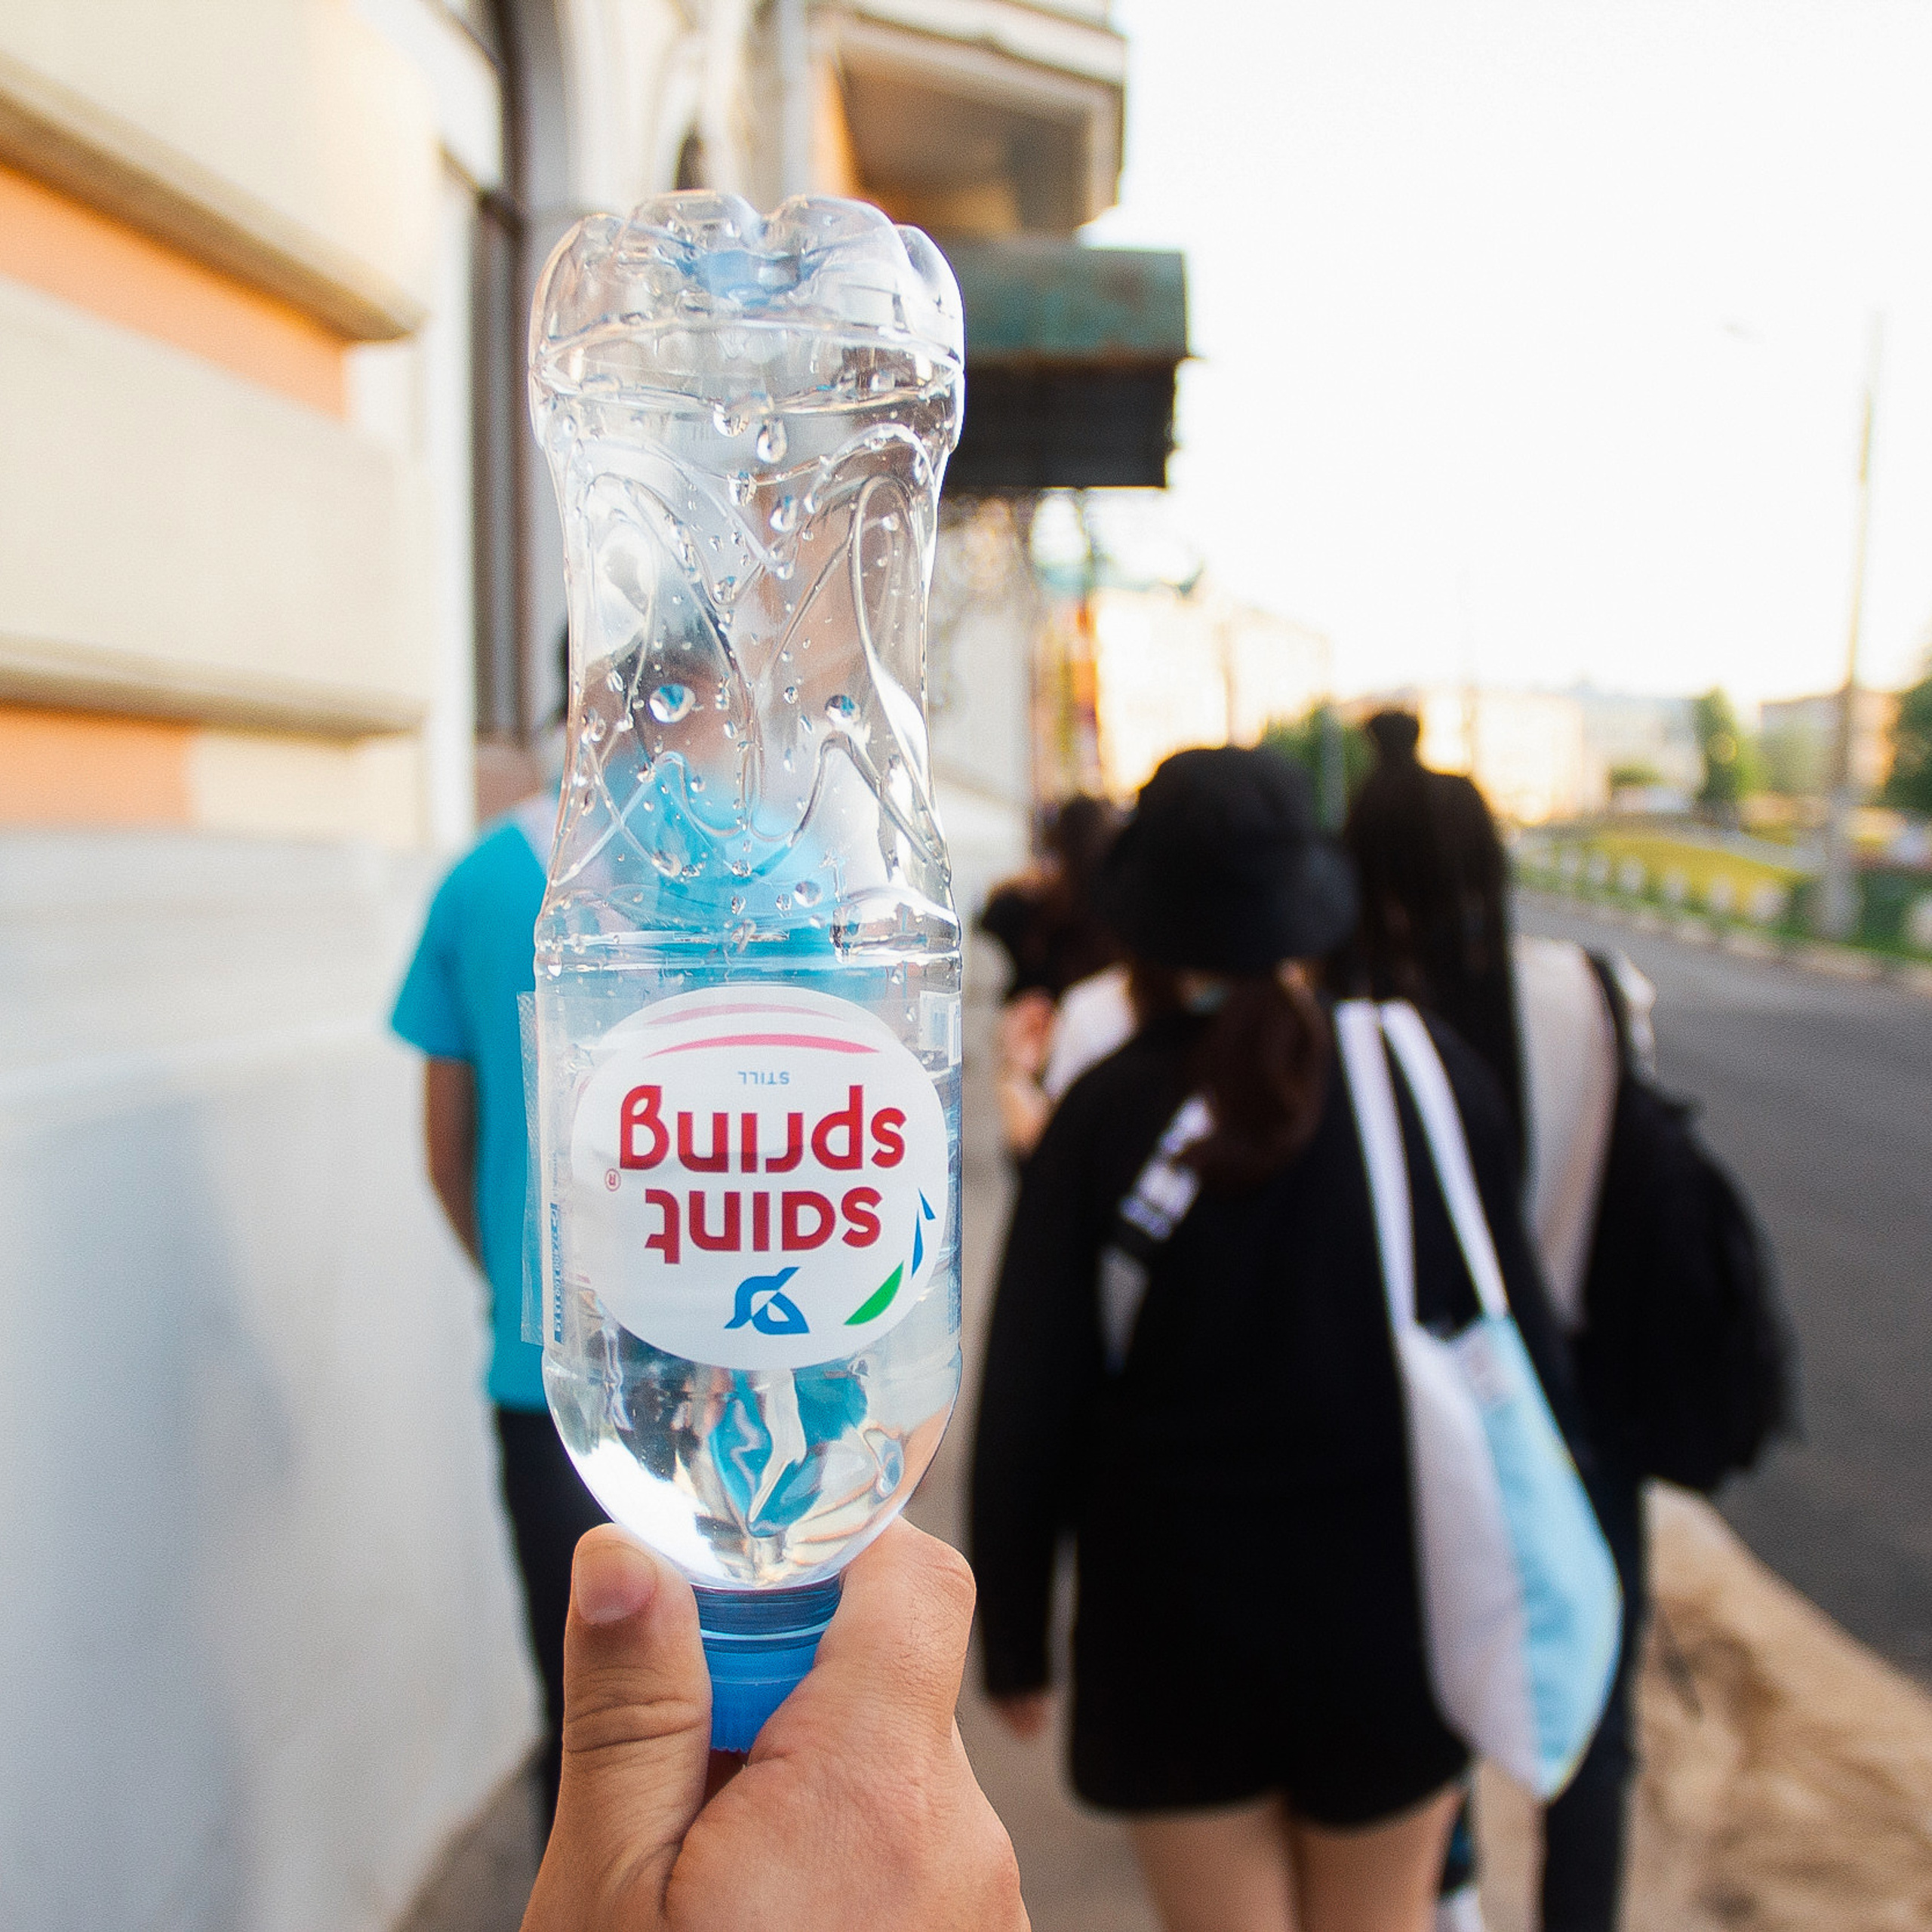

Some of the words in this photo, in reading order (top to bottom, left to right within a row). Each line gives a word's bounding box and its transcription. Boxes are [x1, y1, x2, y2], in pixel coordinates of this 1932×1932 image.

[737, 1070, 790, 1086] STILL
[620, 1084, 906, 1173] spring
[645, 1186, 881, 1263] saint
